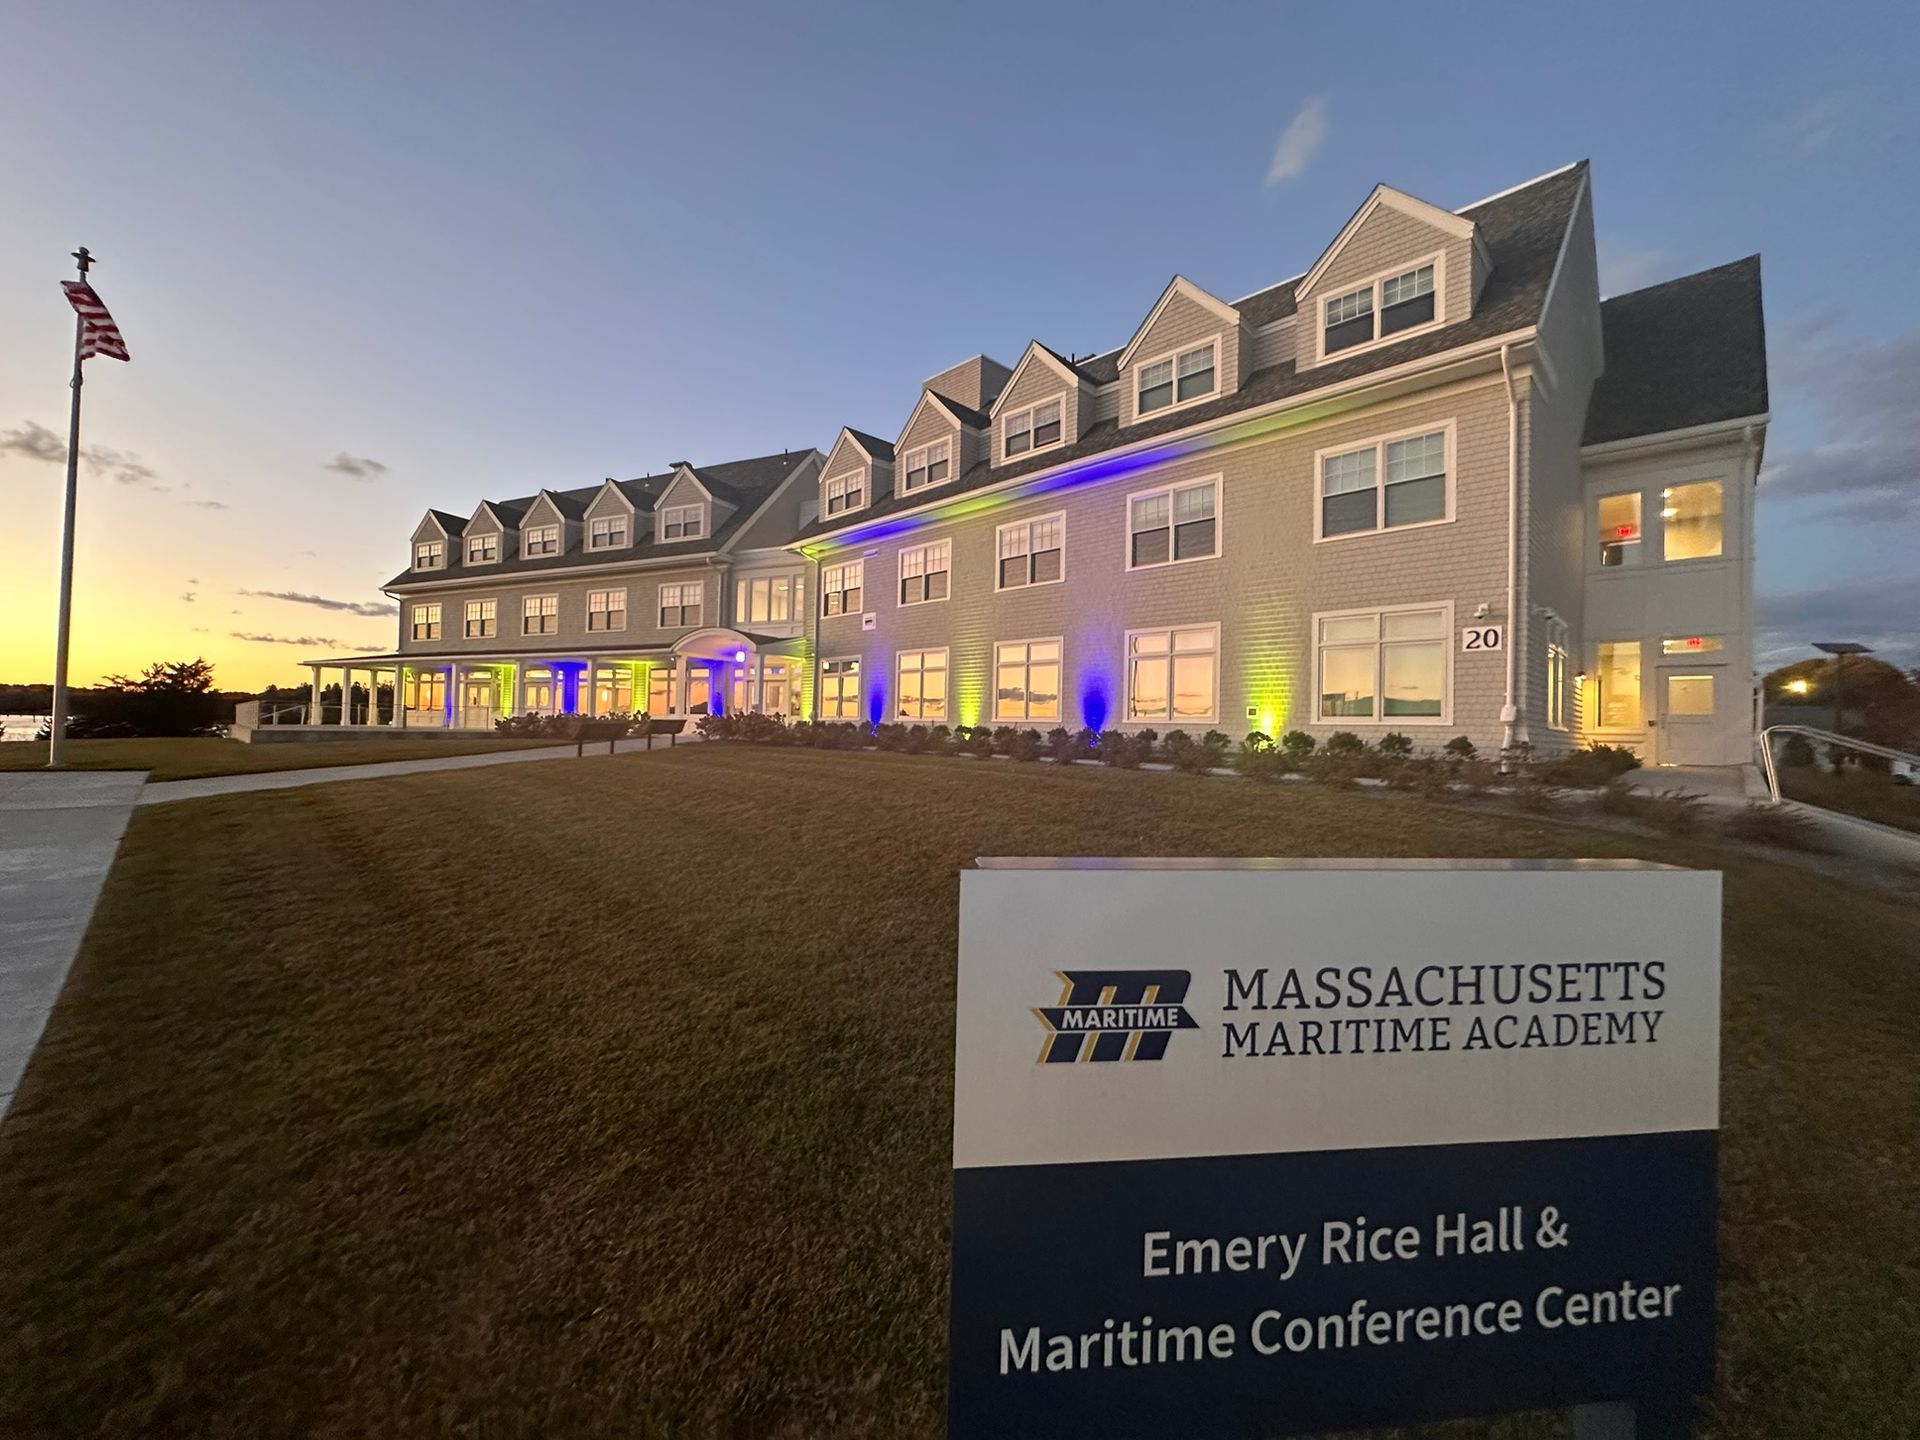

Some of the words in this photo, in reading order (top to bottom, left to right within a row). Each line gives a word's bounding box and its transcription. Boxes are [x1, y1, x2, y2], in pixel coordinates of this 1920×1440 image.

[1465, 628, 1499, 649] 20
[1223, 961, 1667, 1011] MASSACHUSETTS
[1061, 1007, 1179, 1029] MARITIME
[1222, 1017, 1451, 1058] MARITIME
[1462, 1011, 1664, 1051] ACADEMY
[1143, 1231, 1307, 1281] Emery
[1322, 1216, 1420, 1264] Rice
[1435, 1207, 1524, 1257] Hall
[1536, 1206, 1569, 1248] &
[1000, 1317, 1236, 1374] Maritime
[1251, 1299, 1522, 1356] Conference
[1536, 1281, 1682, 1329] Center
